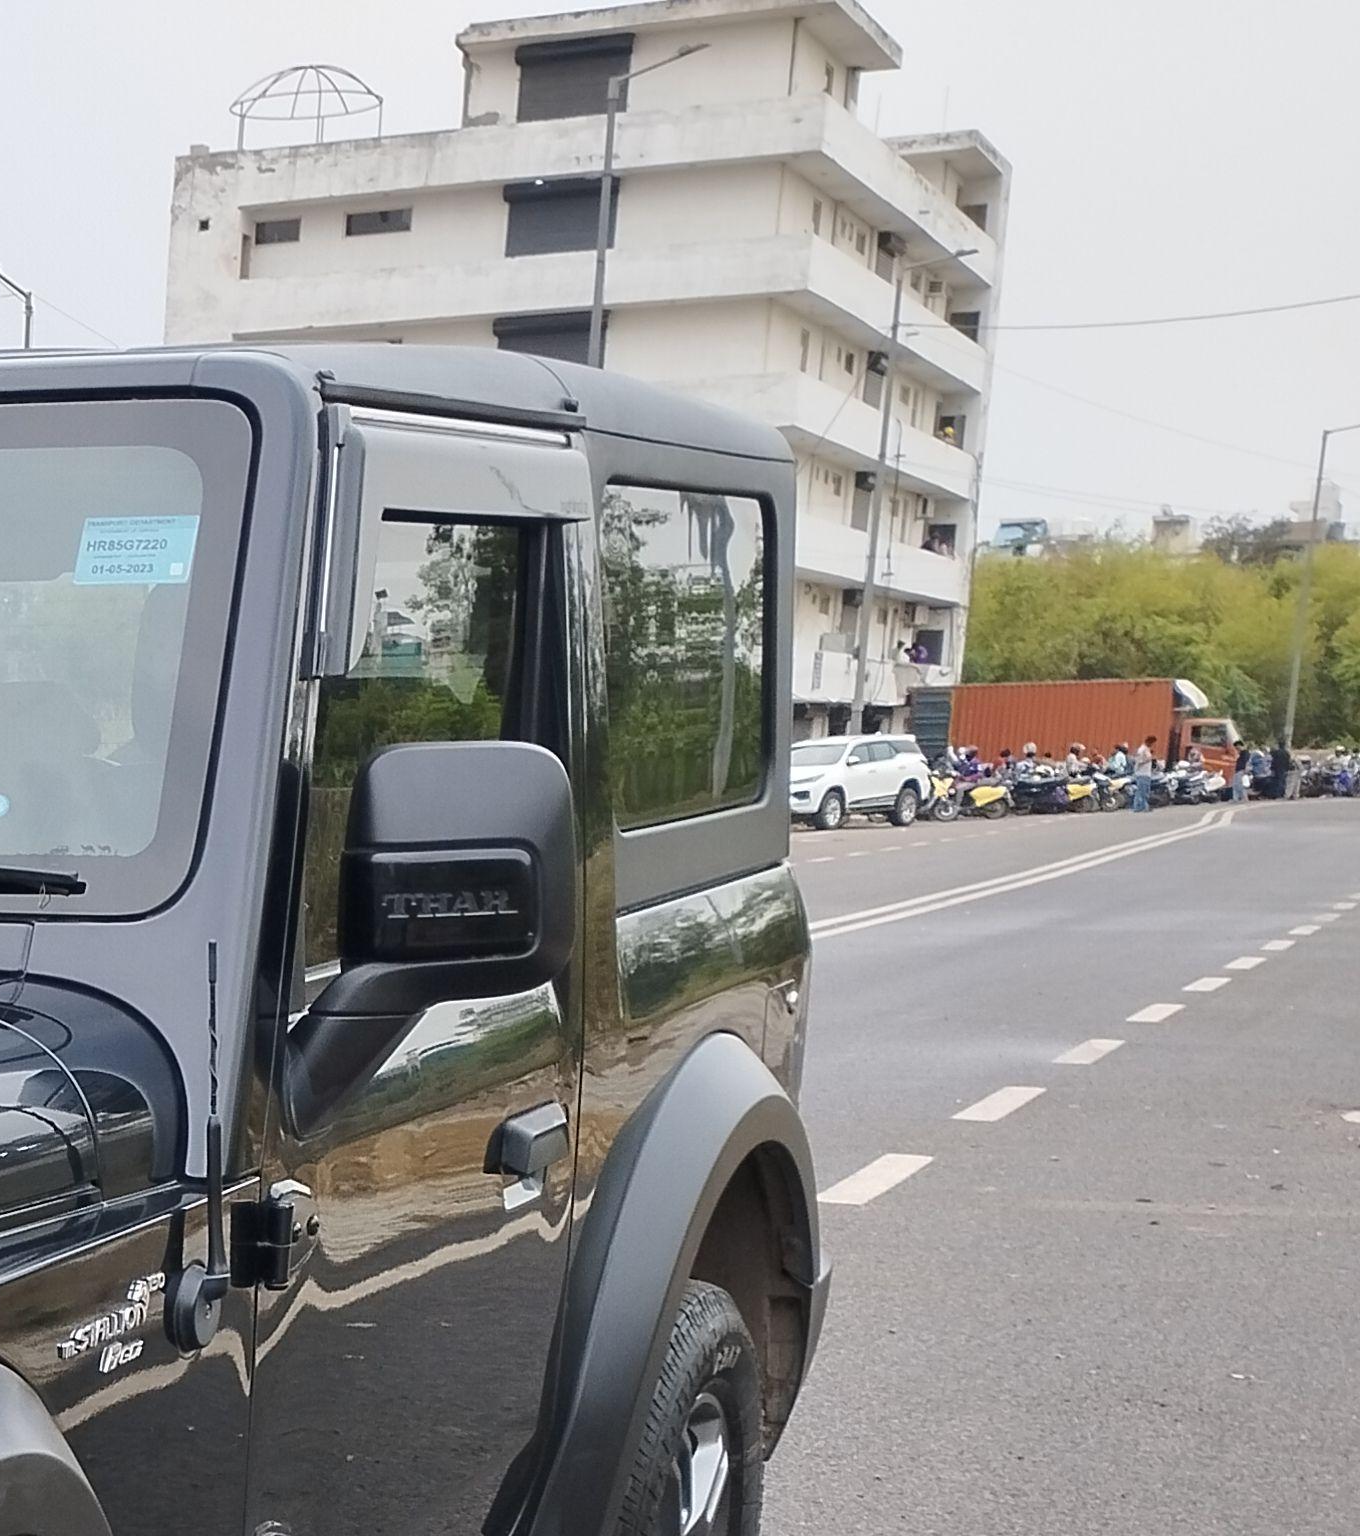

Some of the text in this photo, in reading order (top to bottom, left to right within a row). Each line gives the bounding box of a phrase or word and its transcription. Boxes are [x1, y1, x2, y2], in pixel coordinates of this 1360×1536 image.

[86, 538, 168, 552] HR85G7220
[91, 563, 154, 574] 01-05-2023
[381, 889, 519, 919] THAR
